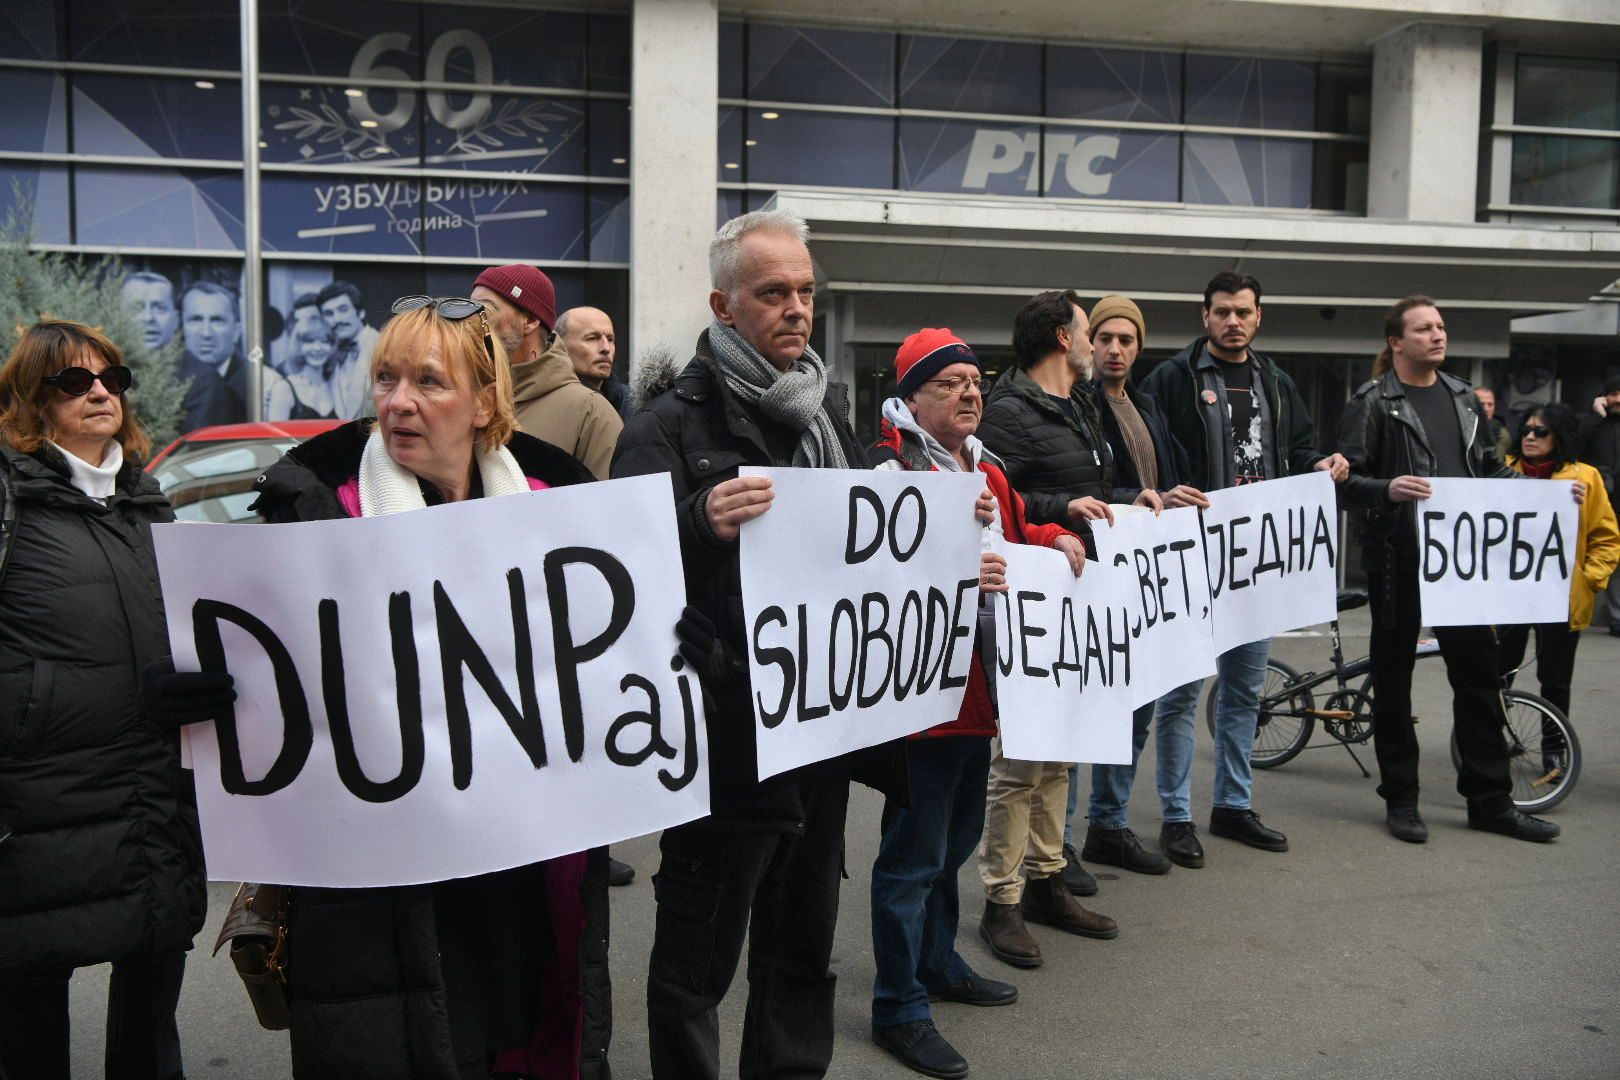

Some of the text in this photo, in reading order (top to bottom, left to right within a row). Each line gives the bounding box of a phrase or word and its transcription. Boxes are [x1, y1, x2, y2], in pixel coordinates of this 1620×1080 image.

[348, 28, 494, 133] 60
[960, 129, 1121, 195] РТС
[387, 213, 463, 234] година
[844, 485, 927, 565] DO
[1206, 504, 1336, 600] ЈЕДНА
[1423, 510, 1568, 583] БОРБА
[192, 545, 699, 804] DUNPaj
[753, 578, 980, 729] SLOBODE
[997, 590, 1132, 695] ЈЕДАН
